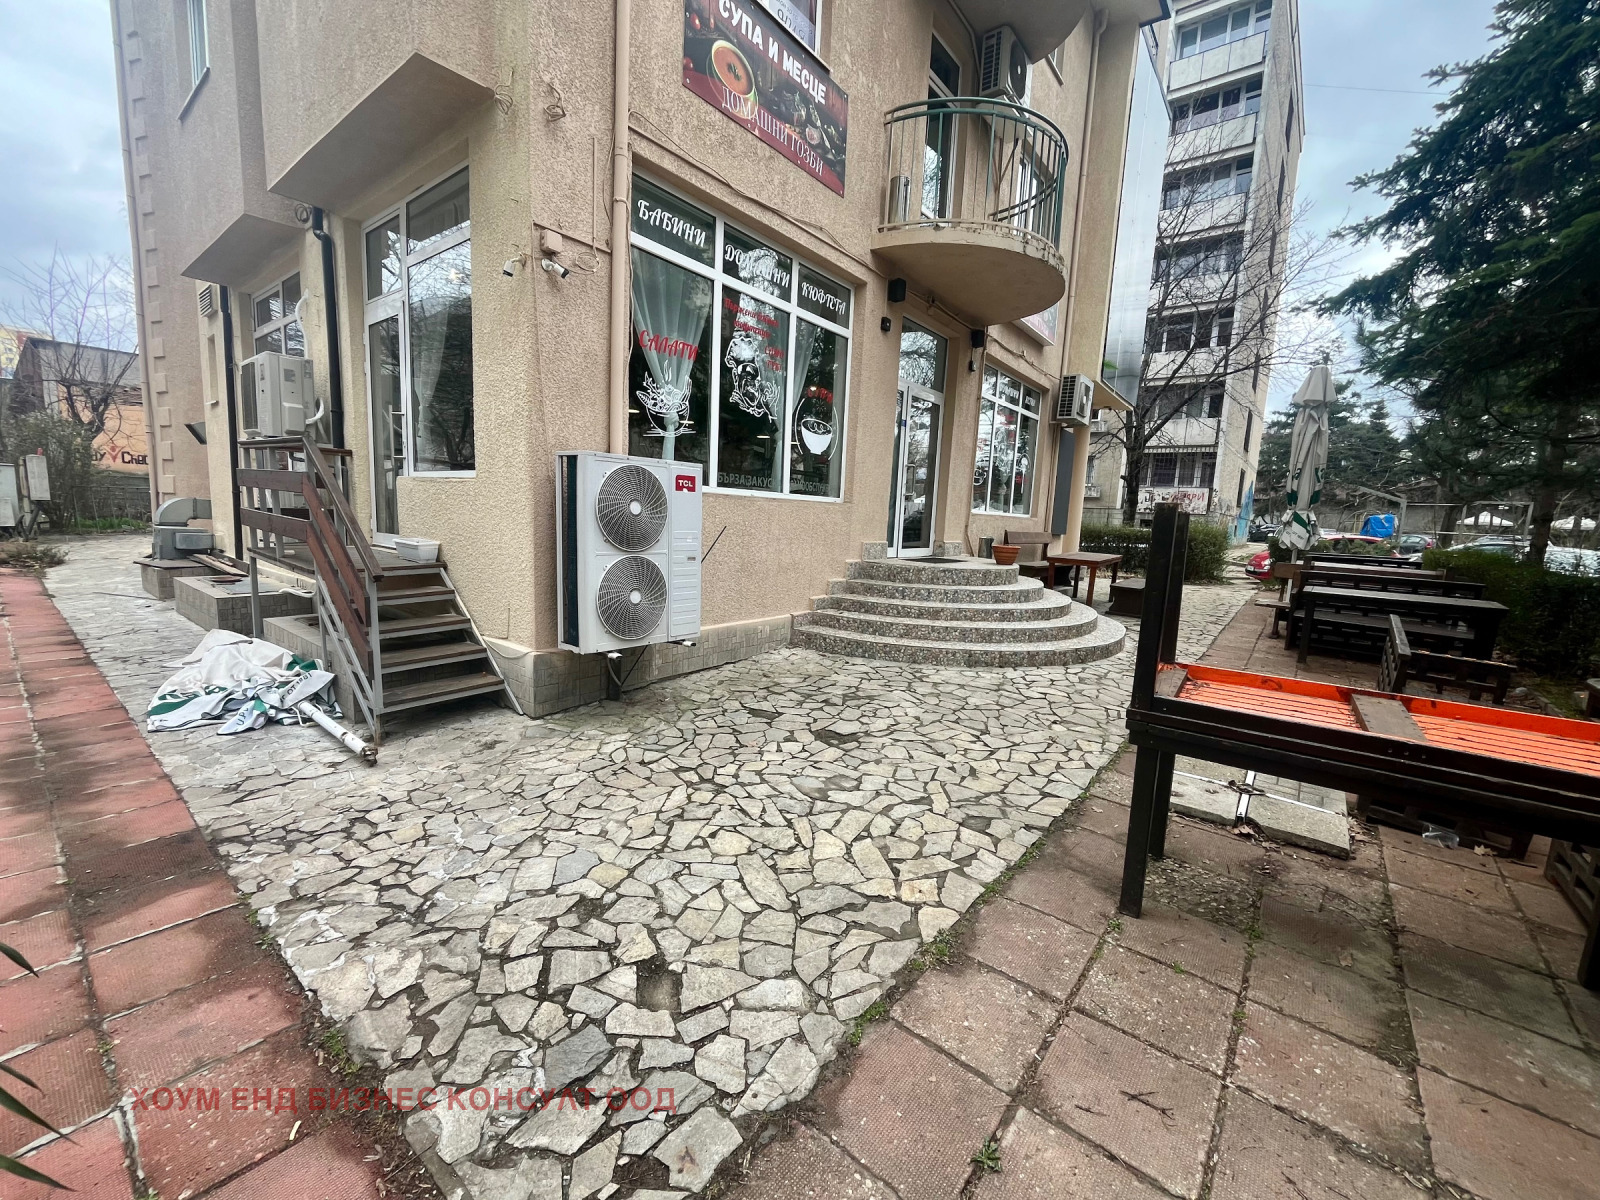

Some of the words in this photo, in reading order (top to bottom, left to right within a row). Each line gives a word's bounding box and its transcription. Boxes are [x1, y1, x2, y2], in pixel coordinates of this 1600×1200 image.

[719, 0, 764, 51] СУПА
[768, 36, 779, 64] И
[782, 50, 827, 105] МЕСЦЕ
[721, 86, 788, 146] ДОМАШНИ
[791, 134, 824, 176] ГОЗБИ
[637, 199, 706, 248] БАБИНИ
[801, 281, 846, 315] КЮФТЕТА
[639, 329, 699, 362] САЛАТИ
[678, 479, 693, 487] TCL
[717, 472, 745, 486] БЪРЗА
